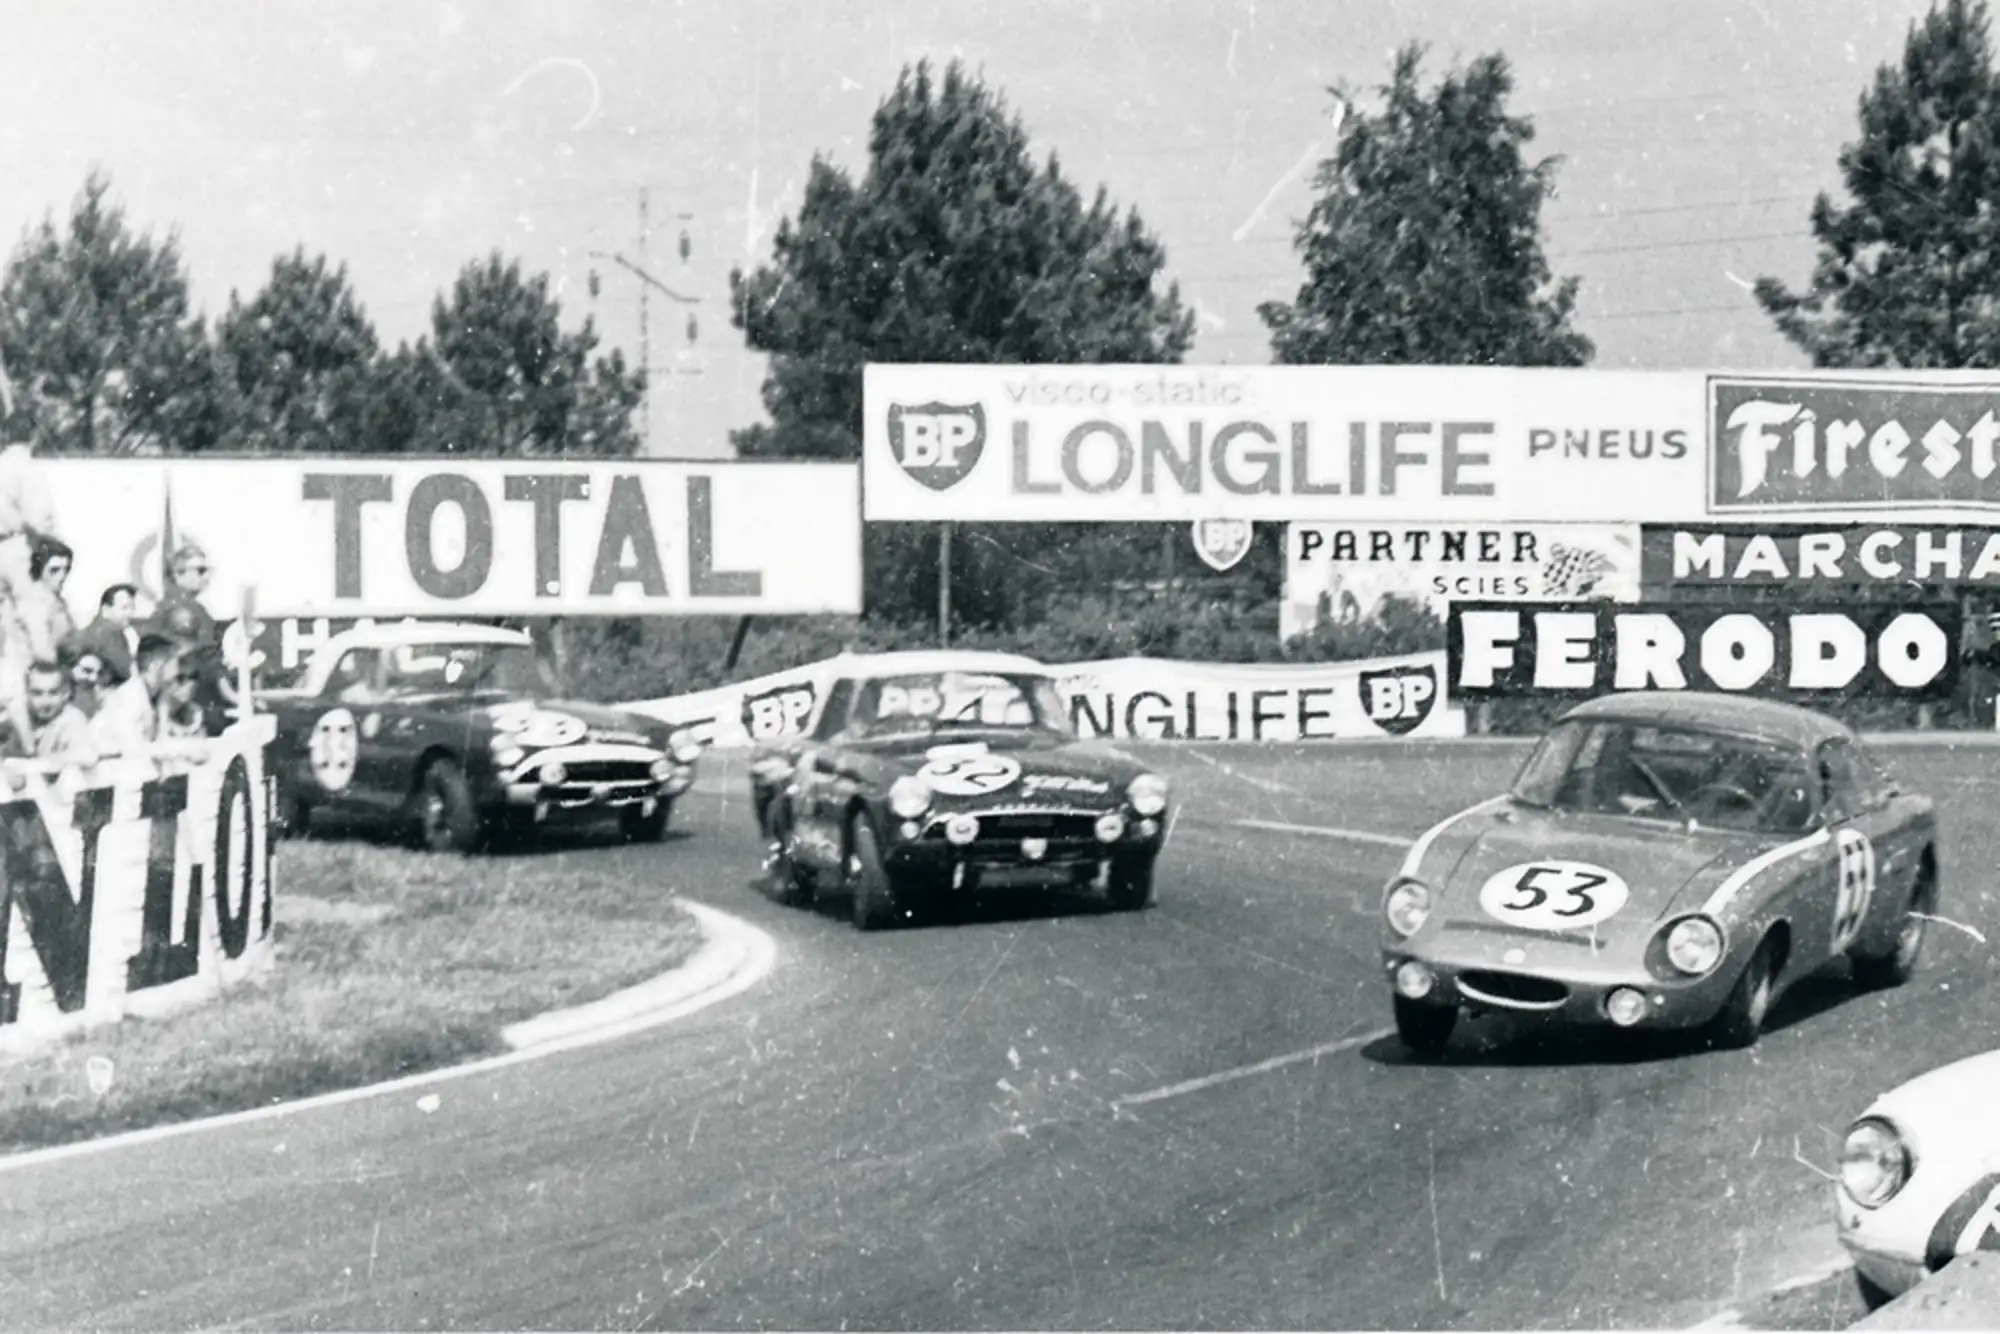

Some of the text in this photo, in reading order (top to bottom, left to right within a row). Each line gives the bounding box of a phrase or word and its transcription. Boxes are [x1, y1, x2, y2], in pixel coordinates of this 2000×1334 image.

[900, 413, 978, 468] BP
[1012, 420, 1495, 495] LONGLIFE
[1527, 428, 1689, 460] PNEUS
[1725, 399, 2000, 499] Firest
[302, 473, 763, 600] TOTAL
[1205, 522, 1245, 552] BP
[1297, 529, 1541, 563] PARTNER
[1431, 575, 1531, 596] SCIES
[1458, 611, 1948, 690] FERODO
[749, 690, 813, 738] BP
[1367, 674, 1434, 720] BP
[1502, 867, 1608, 917] 53
